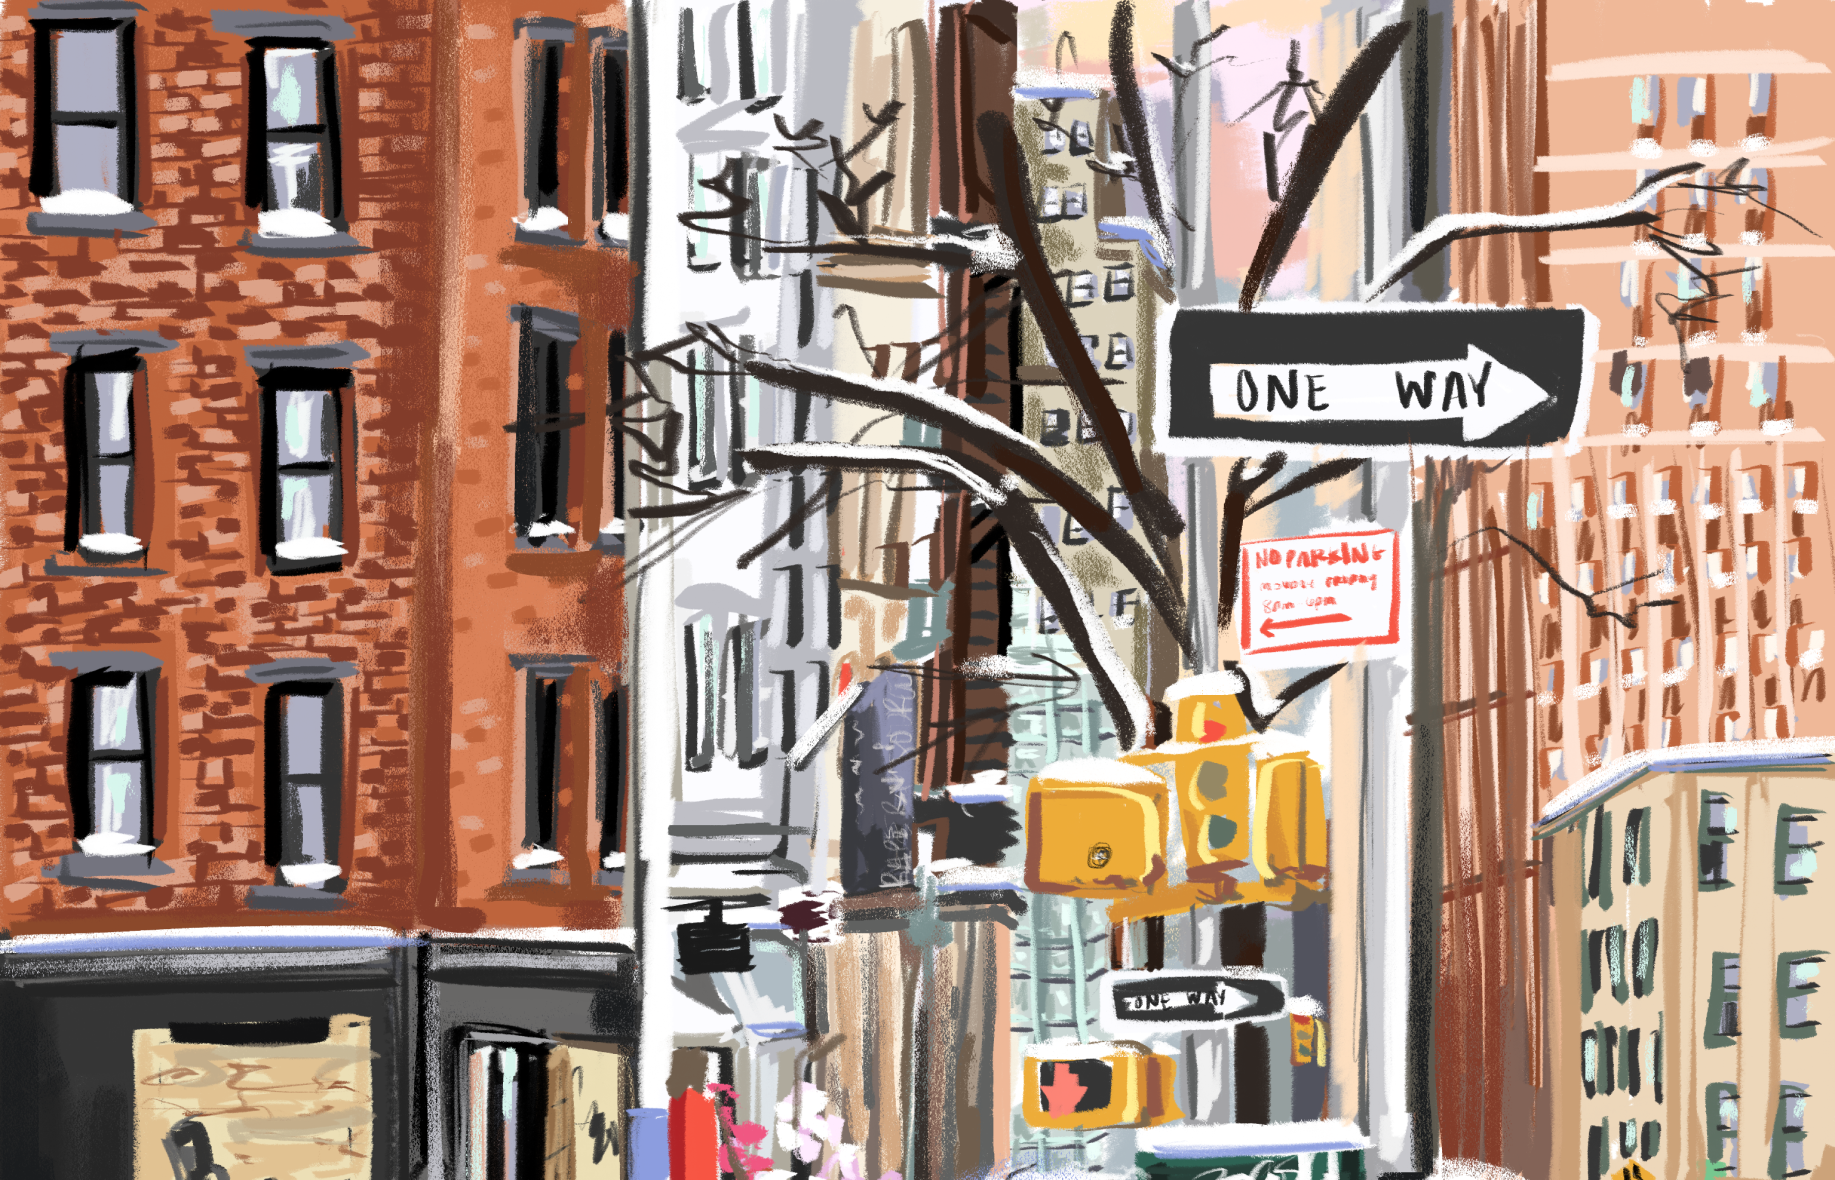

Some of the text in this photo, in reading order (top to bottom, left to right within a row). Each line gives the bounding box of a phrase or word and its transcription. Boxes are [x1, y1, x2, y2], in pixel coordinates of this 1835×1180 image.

[1237, 360, 1493, 413] ONE WAY
[1255, 541, 1388, 570] NO PARKING
[1134, 988, 1227, 1012] ONE WAY
